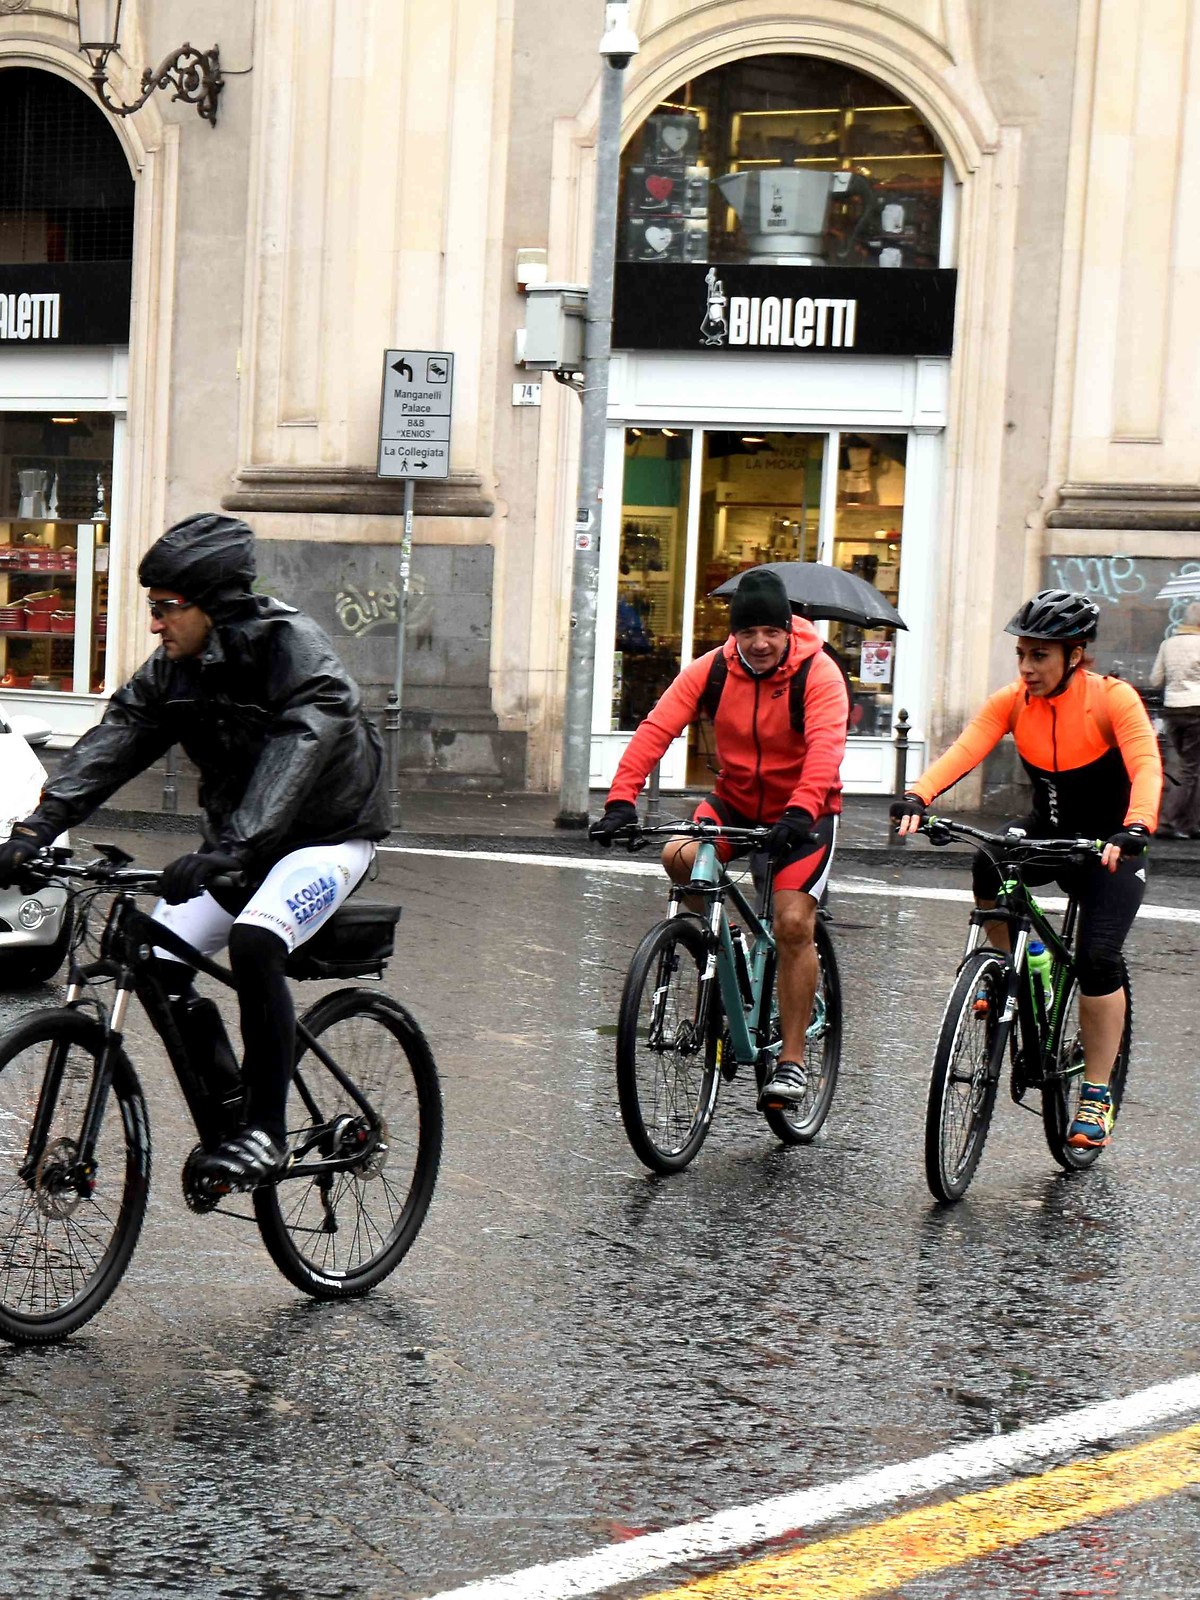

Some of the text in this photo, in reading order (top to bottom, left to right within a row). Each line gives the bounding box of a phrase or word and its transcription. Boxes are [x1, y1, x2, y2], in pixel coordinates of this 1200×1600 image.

[393, 389, 442, 401] Manganelli
[522, 385, 532, 398] 74
[401, 403, 431, 413] Palace
[407, 419, 425, 428] B&B
[384, 446, 444, 459] La Collegiata
[285, 877, 329, 912] ACQUA
[294, 888, 336, 925] SAPONE
